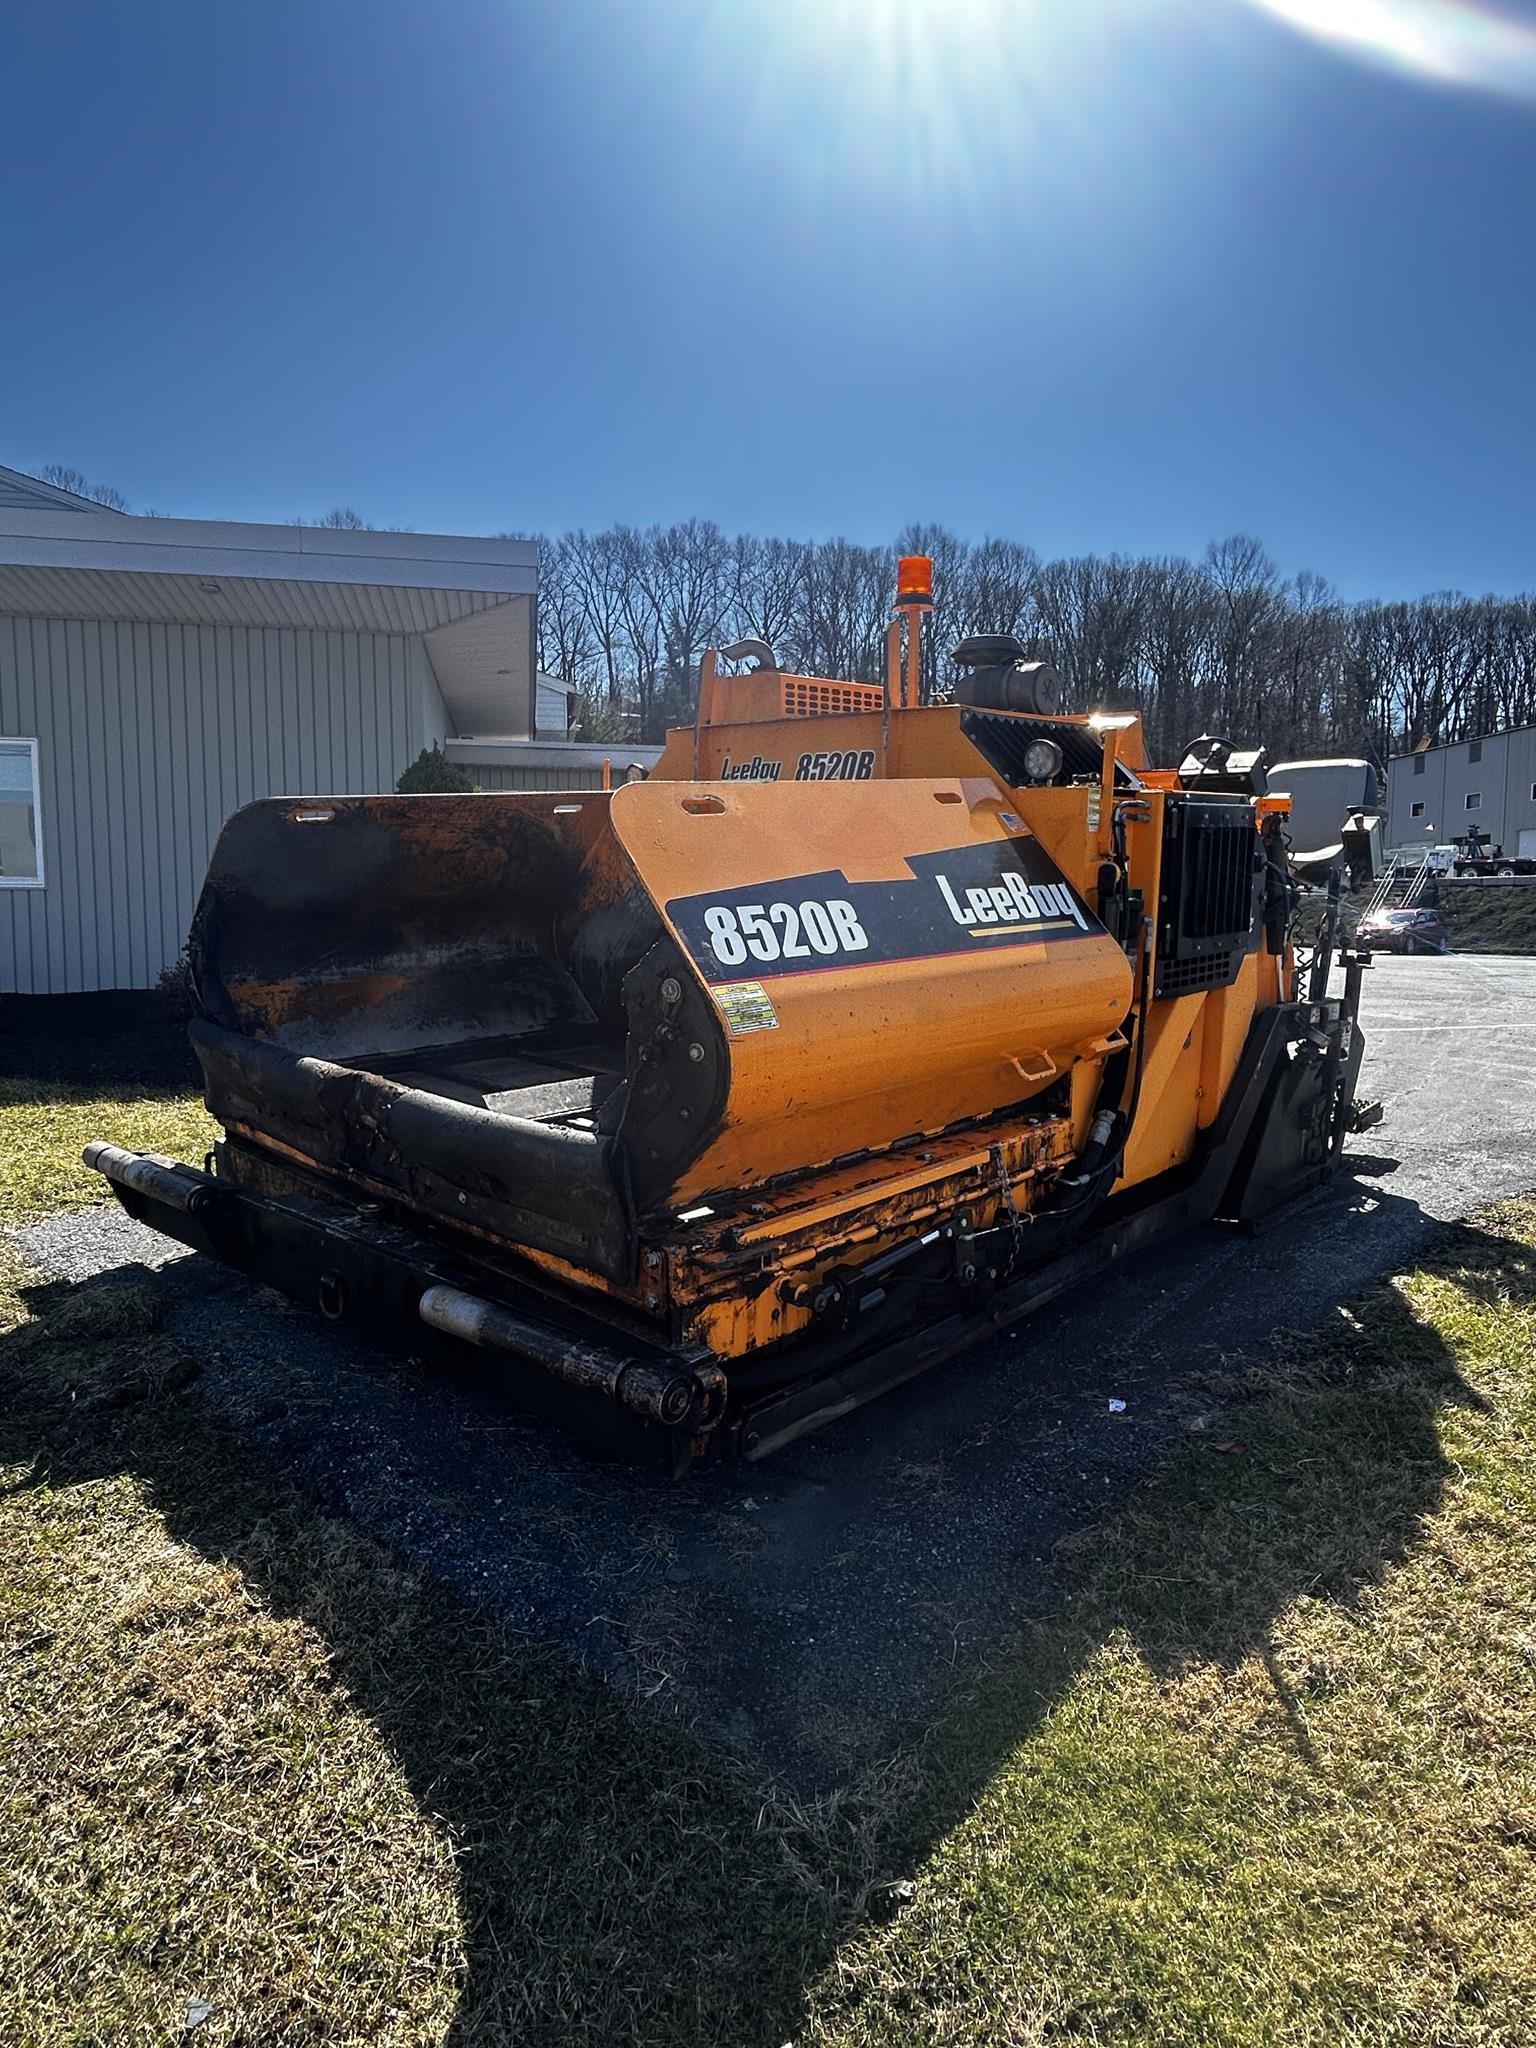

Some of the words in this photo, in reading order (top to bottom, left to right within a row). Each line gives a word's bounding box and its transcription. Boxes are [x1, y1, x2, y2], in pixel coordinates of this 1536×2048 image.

[721, 755, 781, 781] LeeBoy
[795, 750, 875, 781] 8520B
[935, 872, 1088, 931] LeeBoy
[704, 900, 868, 966] 8520B
